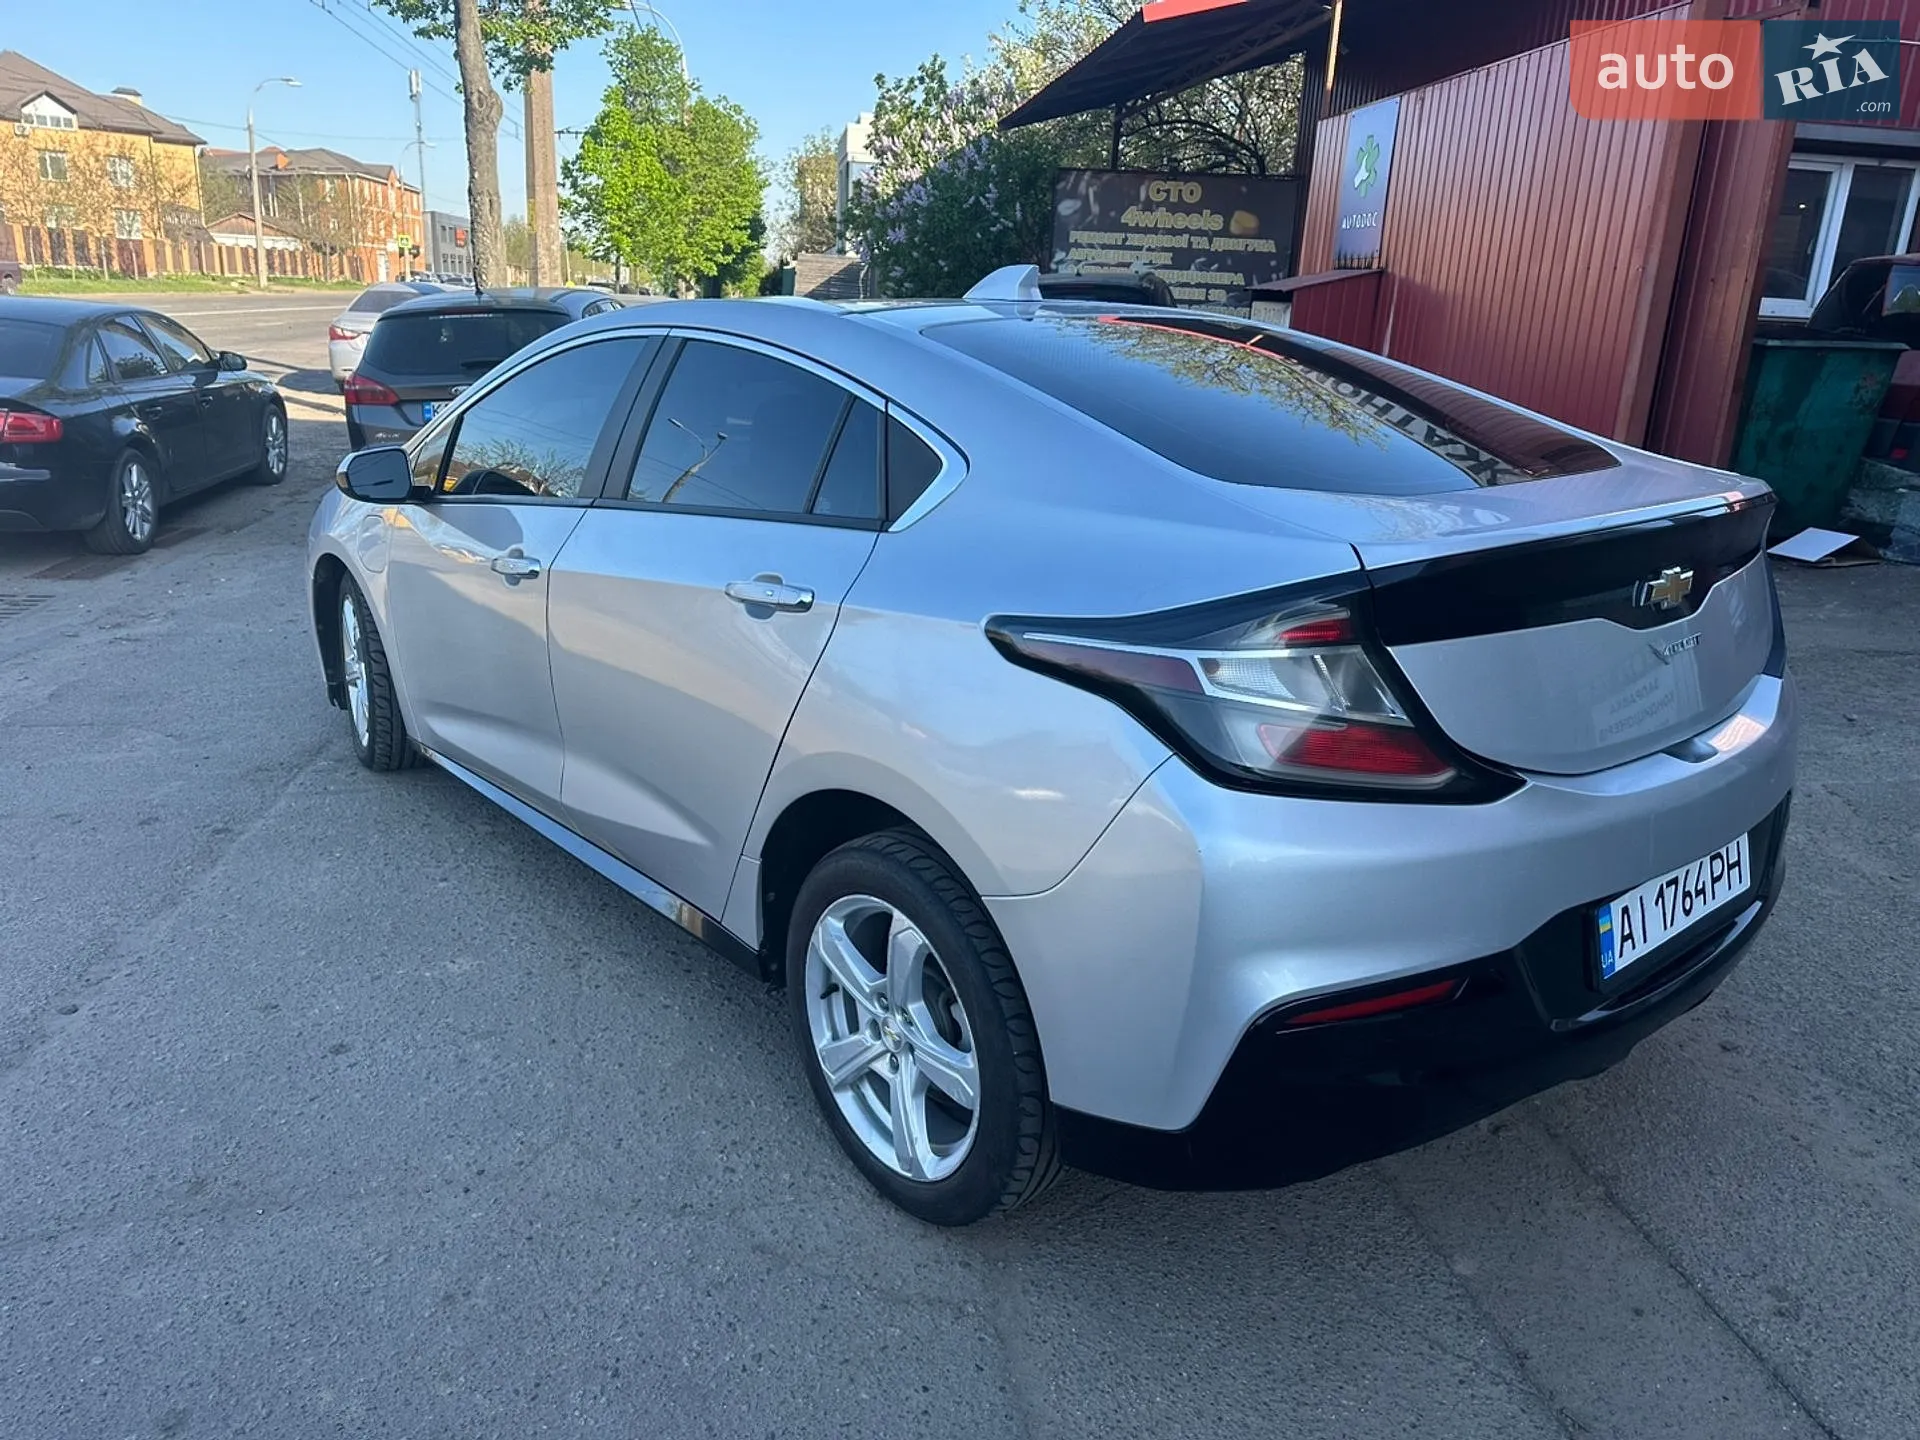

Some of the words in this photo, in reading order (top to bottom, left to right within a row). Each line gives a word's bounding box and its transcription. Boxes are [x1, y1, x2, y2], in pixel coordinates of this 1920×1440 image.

[1148, 180, 1202, 204] СТО
[1121, 206, 1224, 231] 4wheels
[1342, 212, 1378, 230] AUTODOC
[1618, 895, 1648, 959] AI
[1601, 954, 1615, 969] UA
